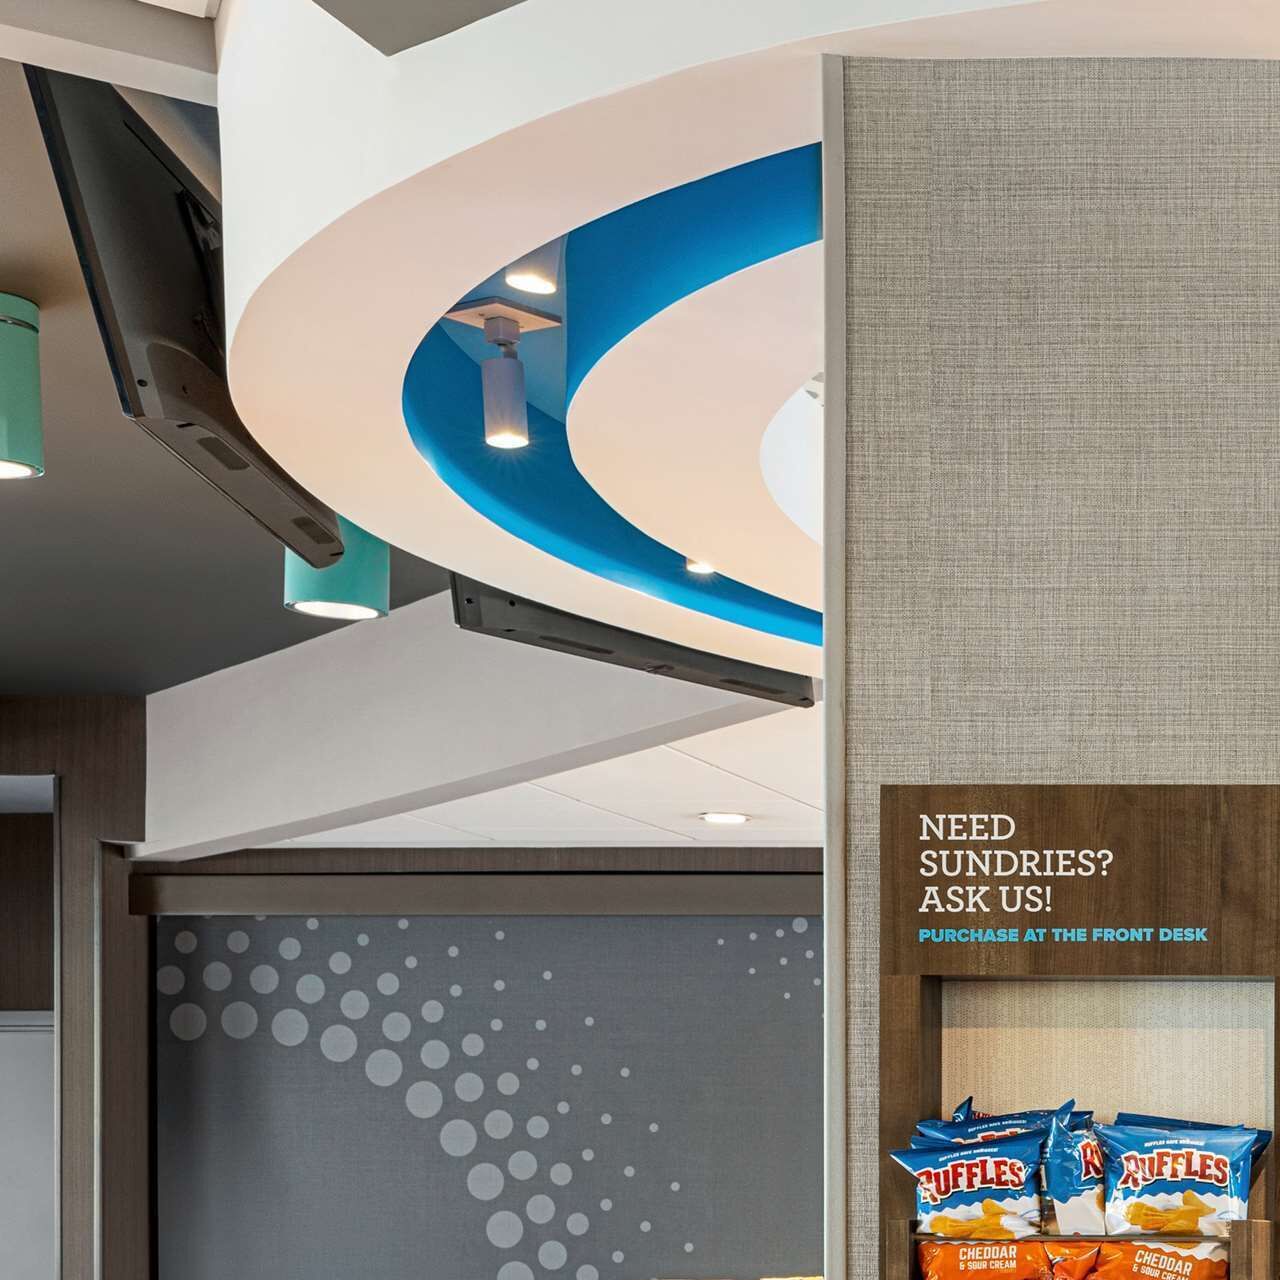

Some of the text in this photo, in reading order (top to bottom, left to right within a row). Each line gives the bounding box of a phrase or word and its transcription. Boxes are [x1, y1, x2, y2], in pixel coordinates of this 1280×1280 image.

[918, 814, 1016, 841] NEED
[918, 849, 1115, 878] SUNDRIES?
[918, 886, 1053, 913] ASK US!
[918, 928, 1209, 944] PURCHASE AT THE FRONT DESK
[916, 1157, 1026, 1204] RUFFLES
[1118, 1150, 1230, 1190] RUFFLES
[958, 1244, 1018, 1261] CHEDDAR
[959, 1260, 1017, 1271] & SOUR CREAM
[1134, 1249, 1193, 1277] CHEDDAR
[1132, 1262, 1139, 1272] &
[1140, 1264, 1160, 1278] SOUR
